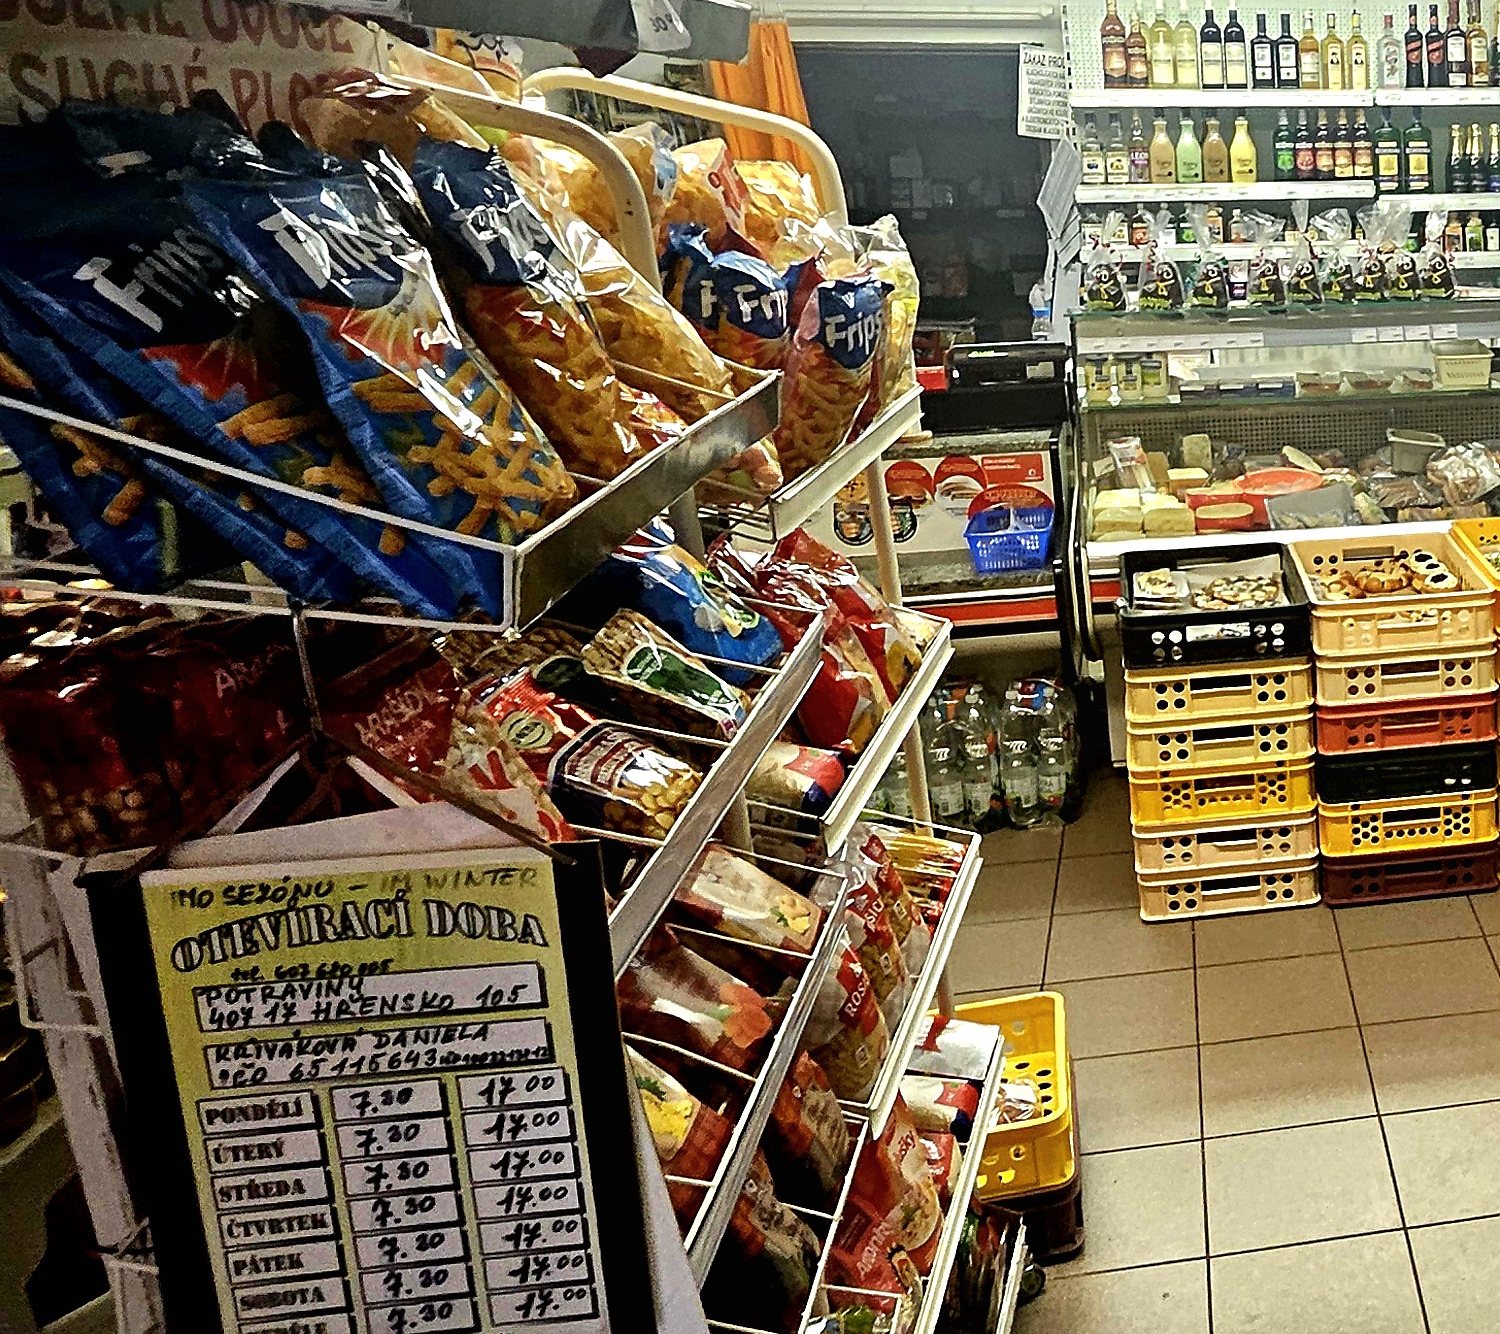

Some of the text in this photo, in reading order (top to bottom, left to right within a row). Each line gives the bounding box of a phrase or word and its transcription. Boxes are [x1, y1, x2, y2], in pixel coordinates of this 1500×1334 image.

[424, 867, 540, 893] WINTER
[170, 889, 549, 973] OTEVÍRACÍ DOBA
[204, 976, 365, 1008] POTRAVINY
[209, 1007, 254, 1032] 407
[265, 1004, 297, 1024] 17
[476, 984, 528, 1009] 105
[373, 1024, 490, 1049] DANIELA
[205, 1098, 304, 1127] PONDĚLÍ
[213, 1138, 286, 1165] ÚTERÝ
[218, 1176, 306, 1204] STŘEDA
[226, 1211, 328, 1239] ČTVRTEK
[232, 1250, 305, 1277] PÁTEK
[240, 1285, 326, 1311] SOBOTA
